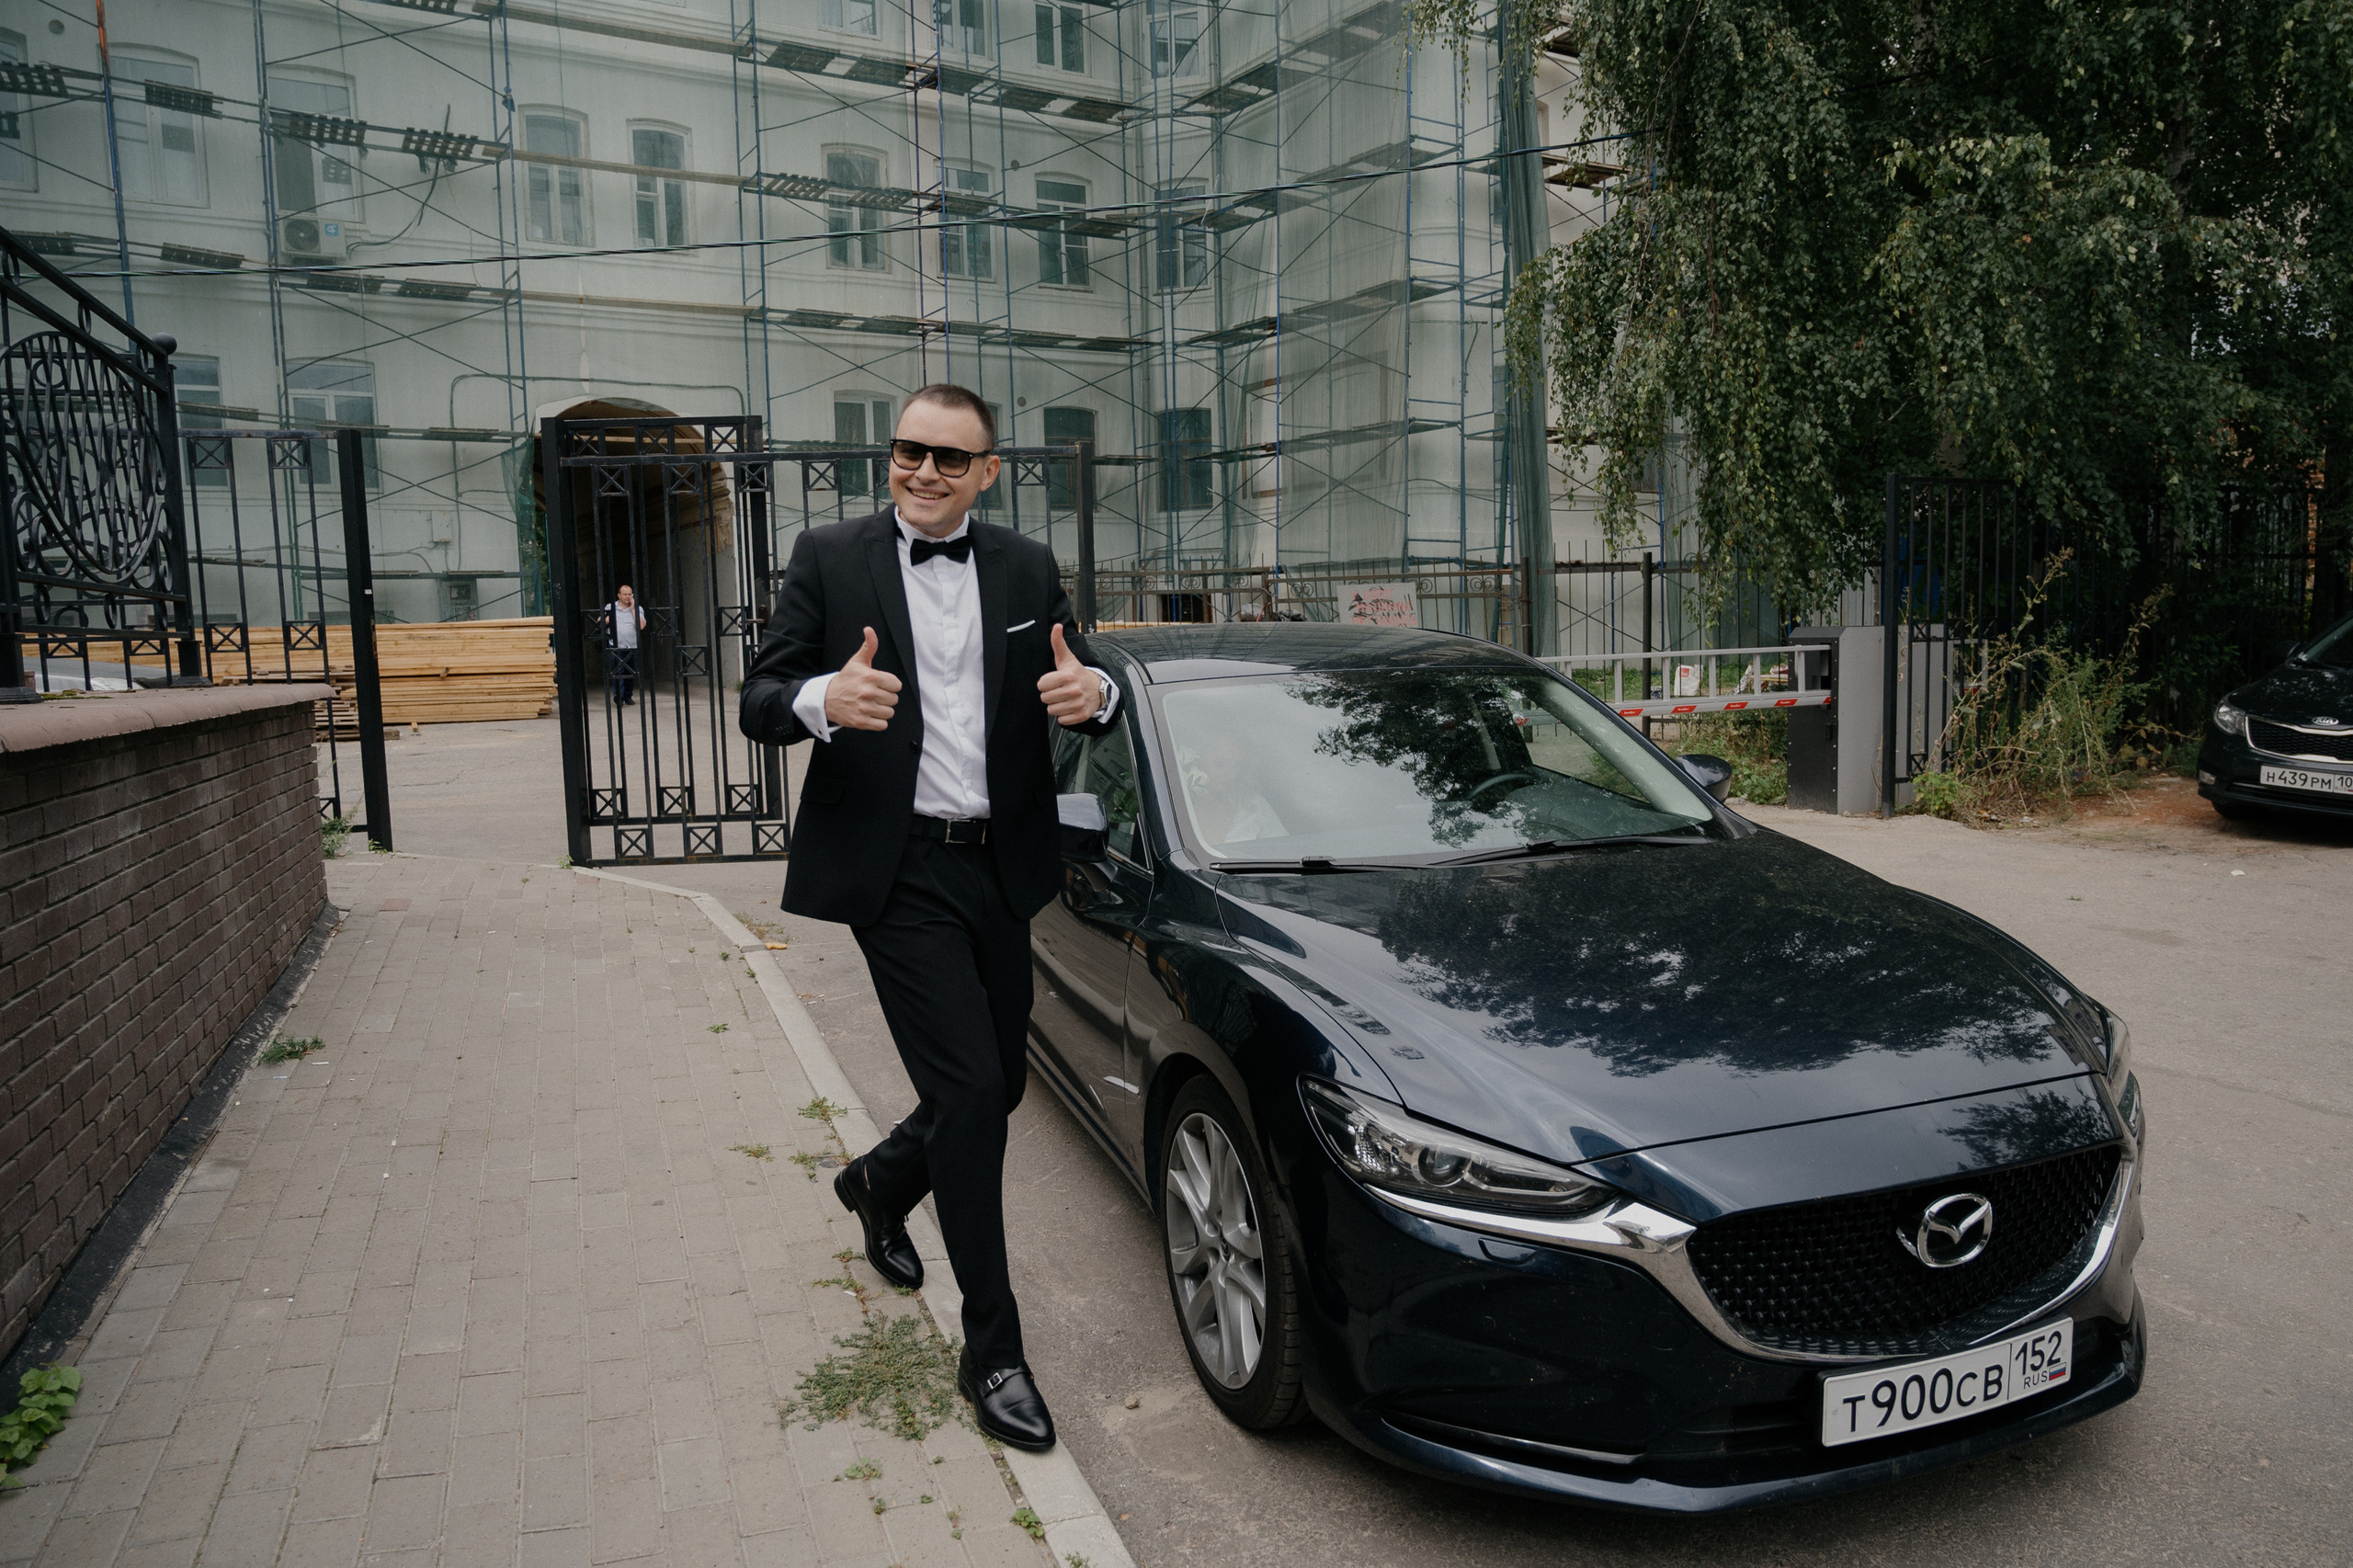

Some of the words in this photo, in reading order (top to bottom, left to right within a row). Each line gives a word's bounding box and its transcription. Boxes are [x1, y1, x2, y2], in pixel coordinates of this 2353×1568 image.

[1842, 1364, 2003, 1433] Т900СВ
[2015, 1330, 2062, 1376] 152
[2024, 1370, 2048, 1390] RUS
